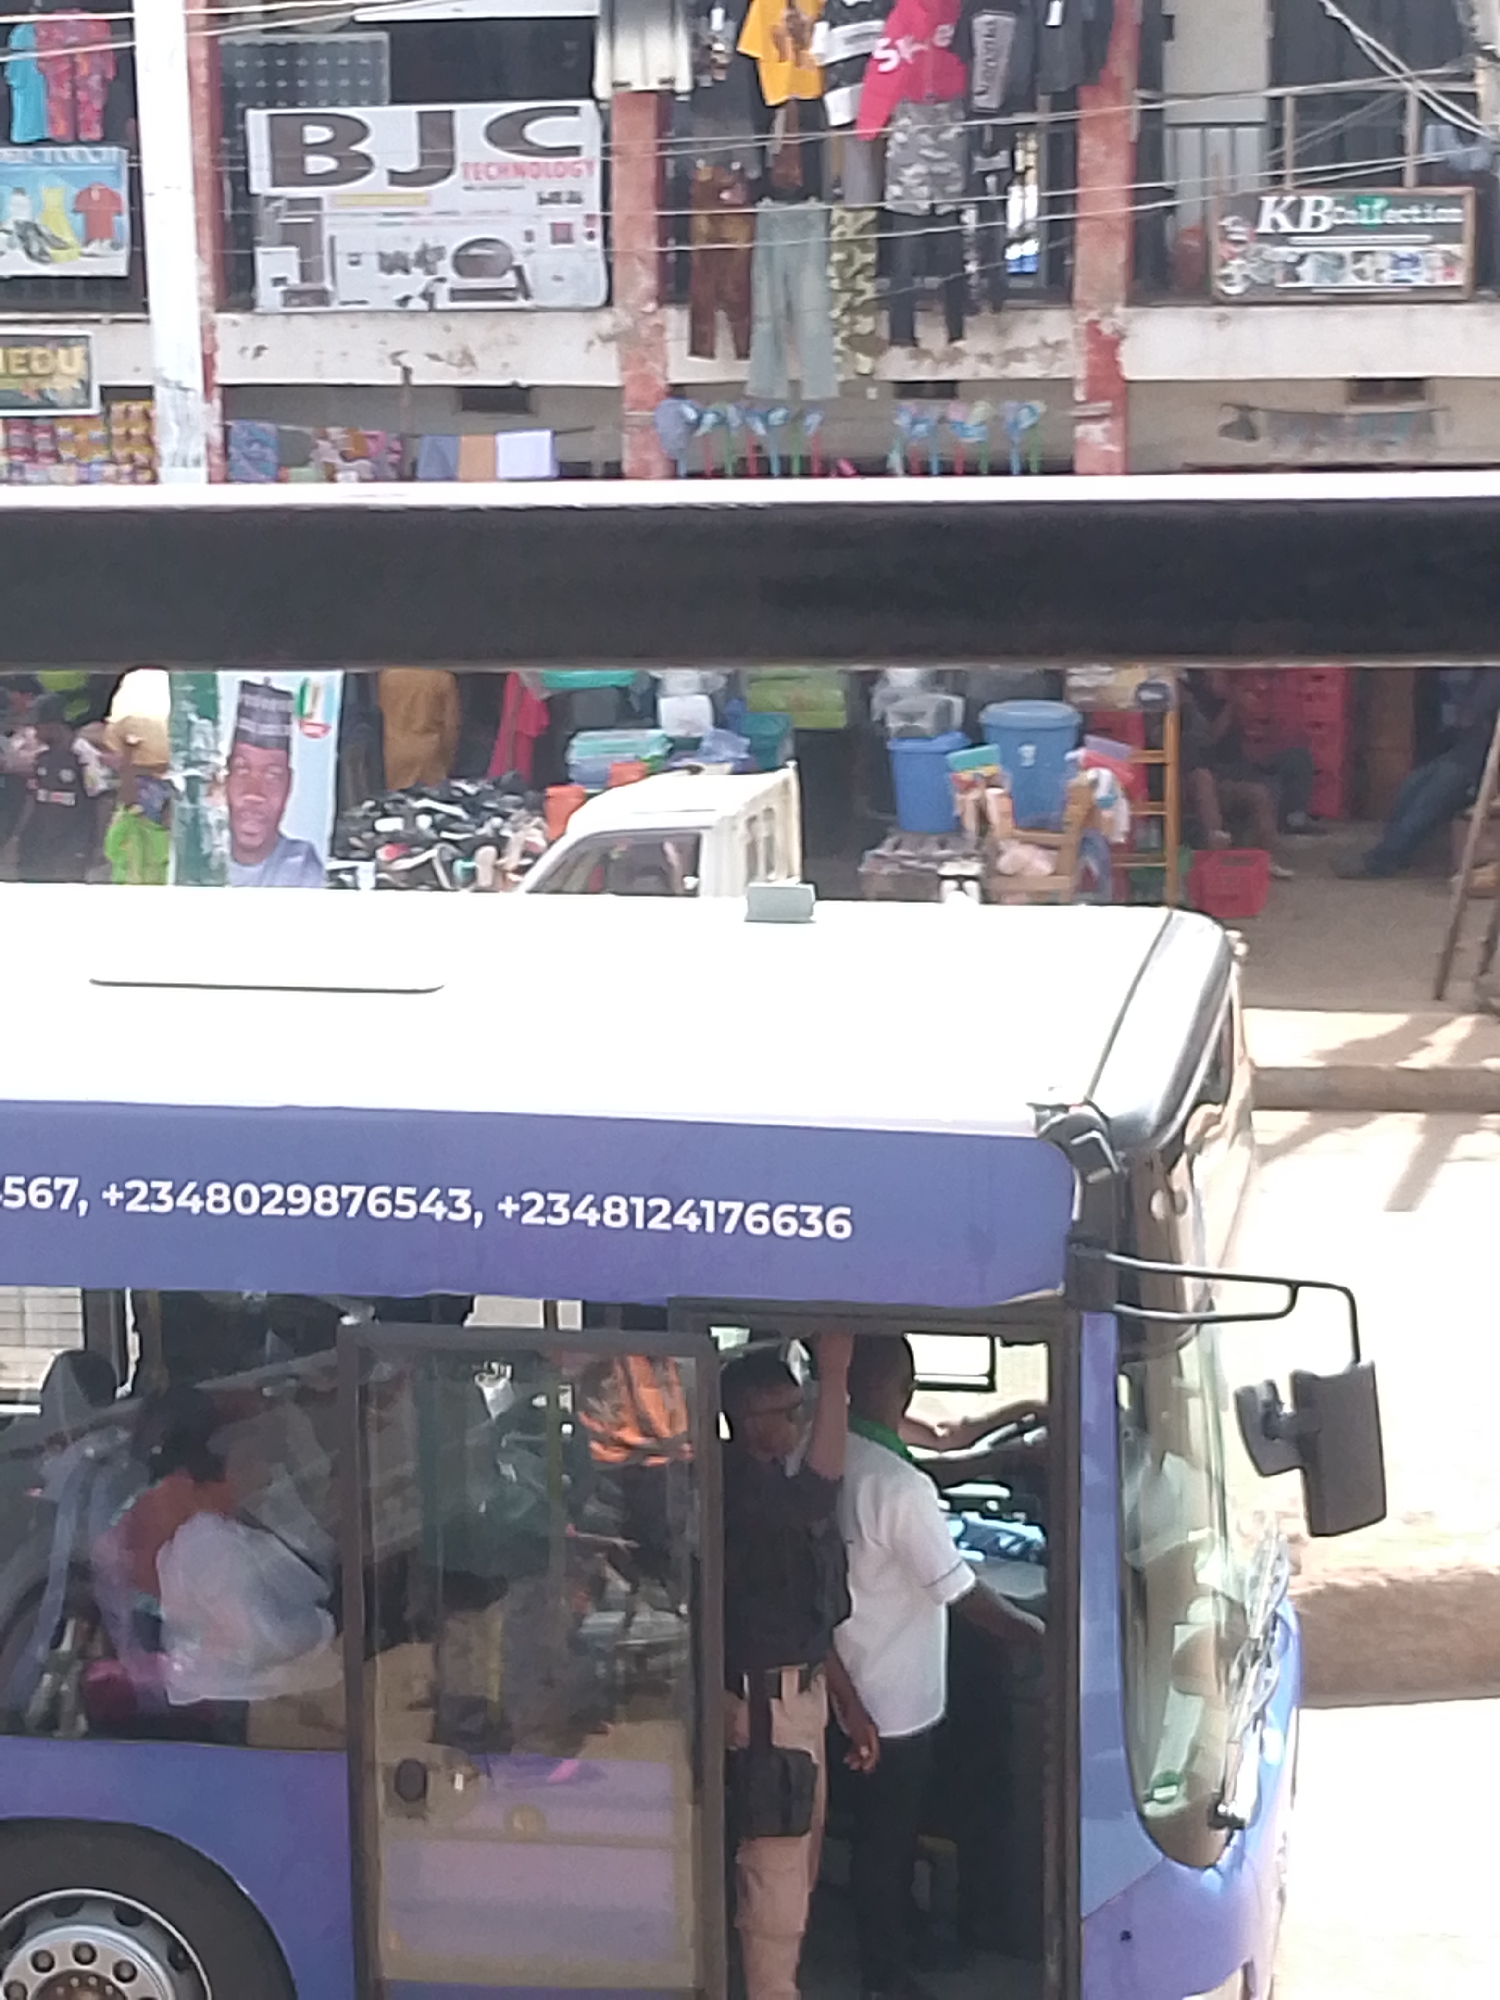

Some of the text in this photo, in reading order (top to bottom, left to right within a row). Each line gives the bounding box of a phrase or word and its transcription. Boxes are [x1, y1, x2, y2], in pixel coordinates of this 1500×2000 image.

[268, 105, 584, 188] BJC
[461, 160, 595, 181] TECHNOLOGY
[1256, 195, 1335, 233] KB
[0, 1175, 852, 1240] 567, +2348029876543, +2348124176636
